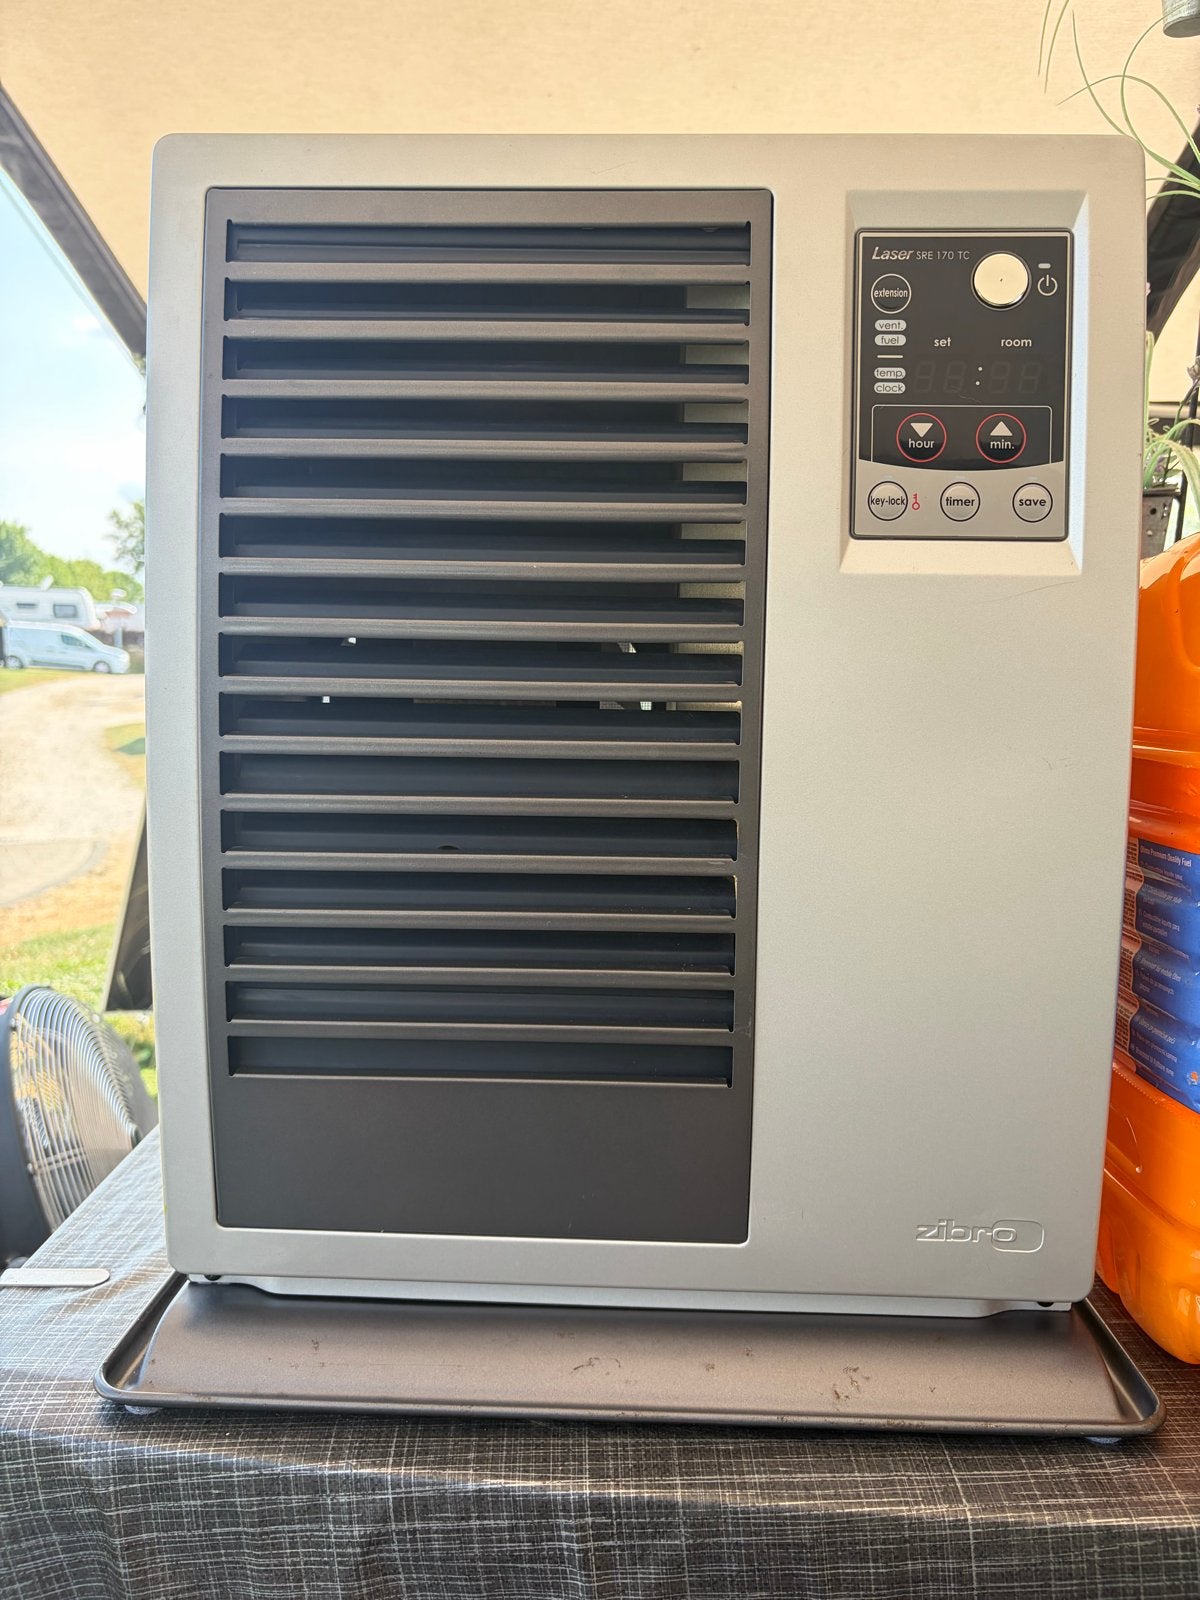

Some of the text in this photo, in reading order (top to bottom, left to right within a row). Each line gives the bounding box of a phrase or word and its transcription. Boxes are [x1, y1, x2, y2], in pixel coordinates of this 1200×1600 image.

[872, 246, 970, 260] Laser SRE 170 TC
[873, 287, 908, 298] extension
[879, 321, 904, 330] vent.
[881, 335, 900, 345] fuel
[933, 337, 952, 347] set
[1000, 337, 1032, 347] room
[875, 383, 904, 393] clock
[908, 437, 935, 449] hour
[990, 439, 1015, 450] min.
[870, 495, 906, 506] key-lock
[945, 496, 975, 507] timer
[1018, 497, 1047, 507] save
[1181, 857, 1192, 867] Fuel
[915, 1218, 1018, 1243] zibro
